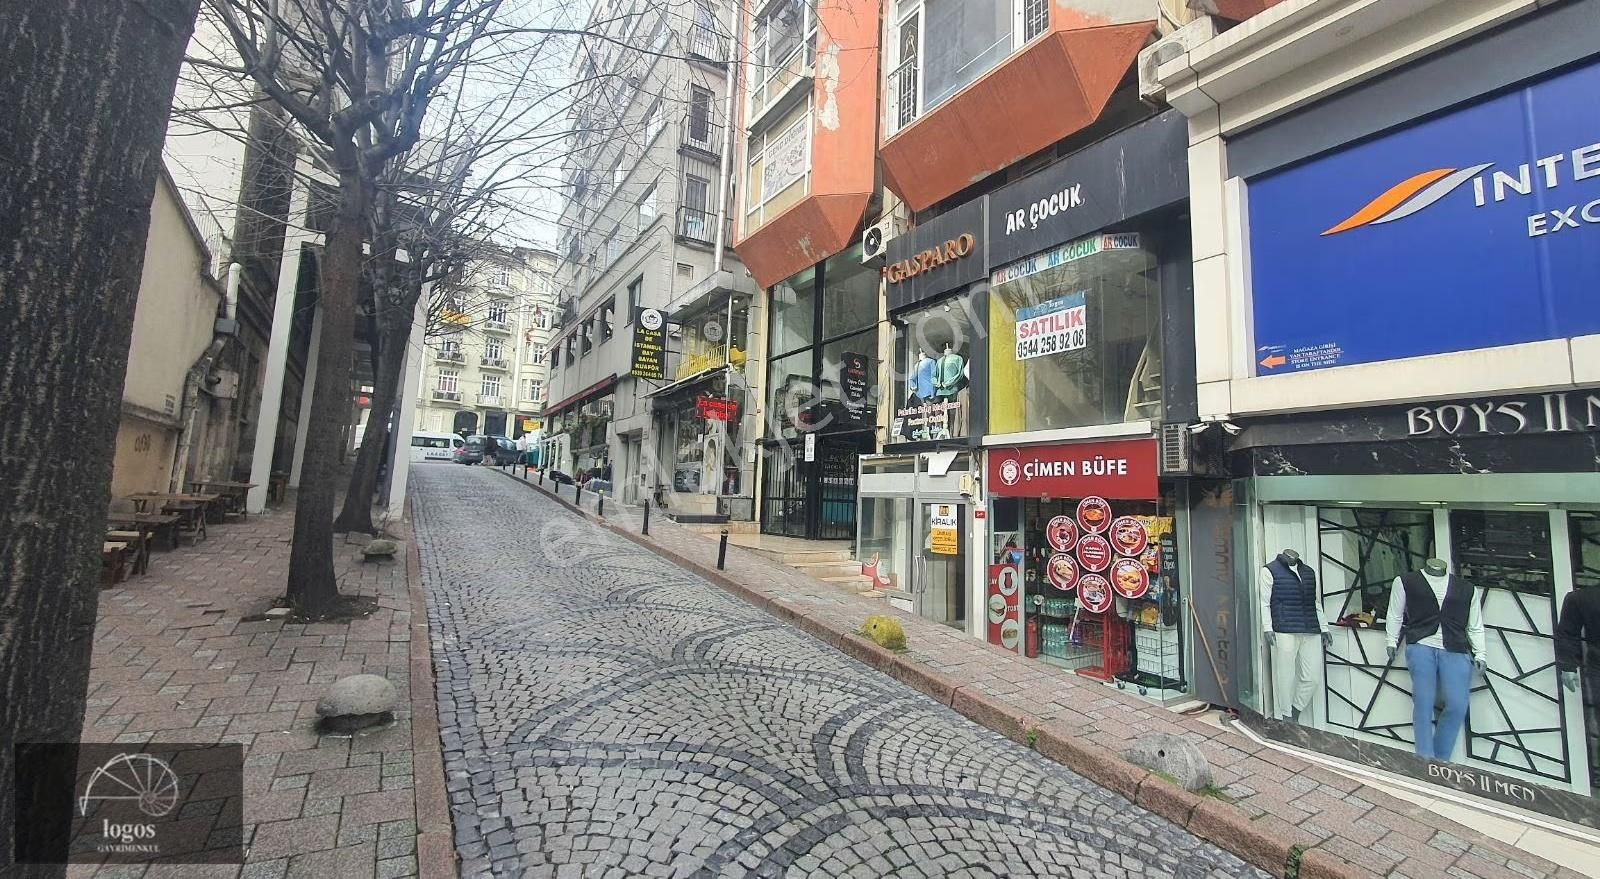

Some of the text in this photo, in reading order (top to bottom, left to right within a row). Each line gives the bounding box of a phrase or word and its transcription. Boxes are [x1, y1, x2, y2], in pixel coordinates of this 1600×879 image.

[1473, 142, 1600, 207] INTE
[1006, 183, 1081, 235] AR ÇOCUK
[1103, 236, 1113, 250] AR
[887, 233, 976, 284] GASPARO
[1048, 251, 1060, 267] AR
[1019, 309, 1084, 339] SATILIK
[1017, 338, 1038, 358] 0544
[1041, 334, 1057, 354] 258
[1059, 331, 1070, 350] 92
[1405, 401, 1528, 435] BOYS
[1541, 393, 1573, 432] II
[1023, 458, 1075, 481] ÇİMEN
[1082, 455, 1127, 476] BÜFE
[932, 516, 957, 526] KİRALIK
[1428, 763, 1476, 787] BOYS
[1495, 780, 1535, 801] MEN
